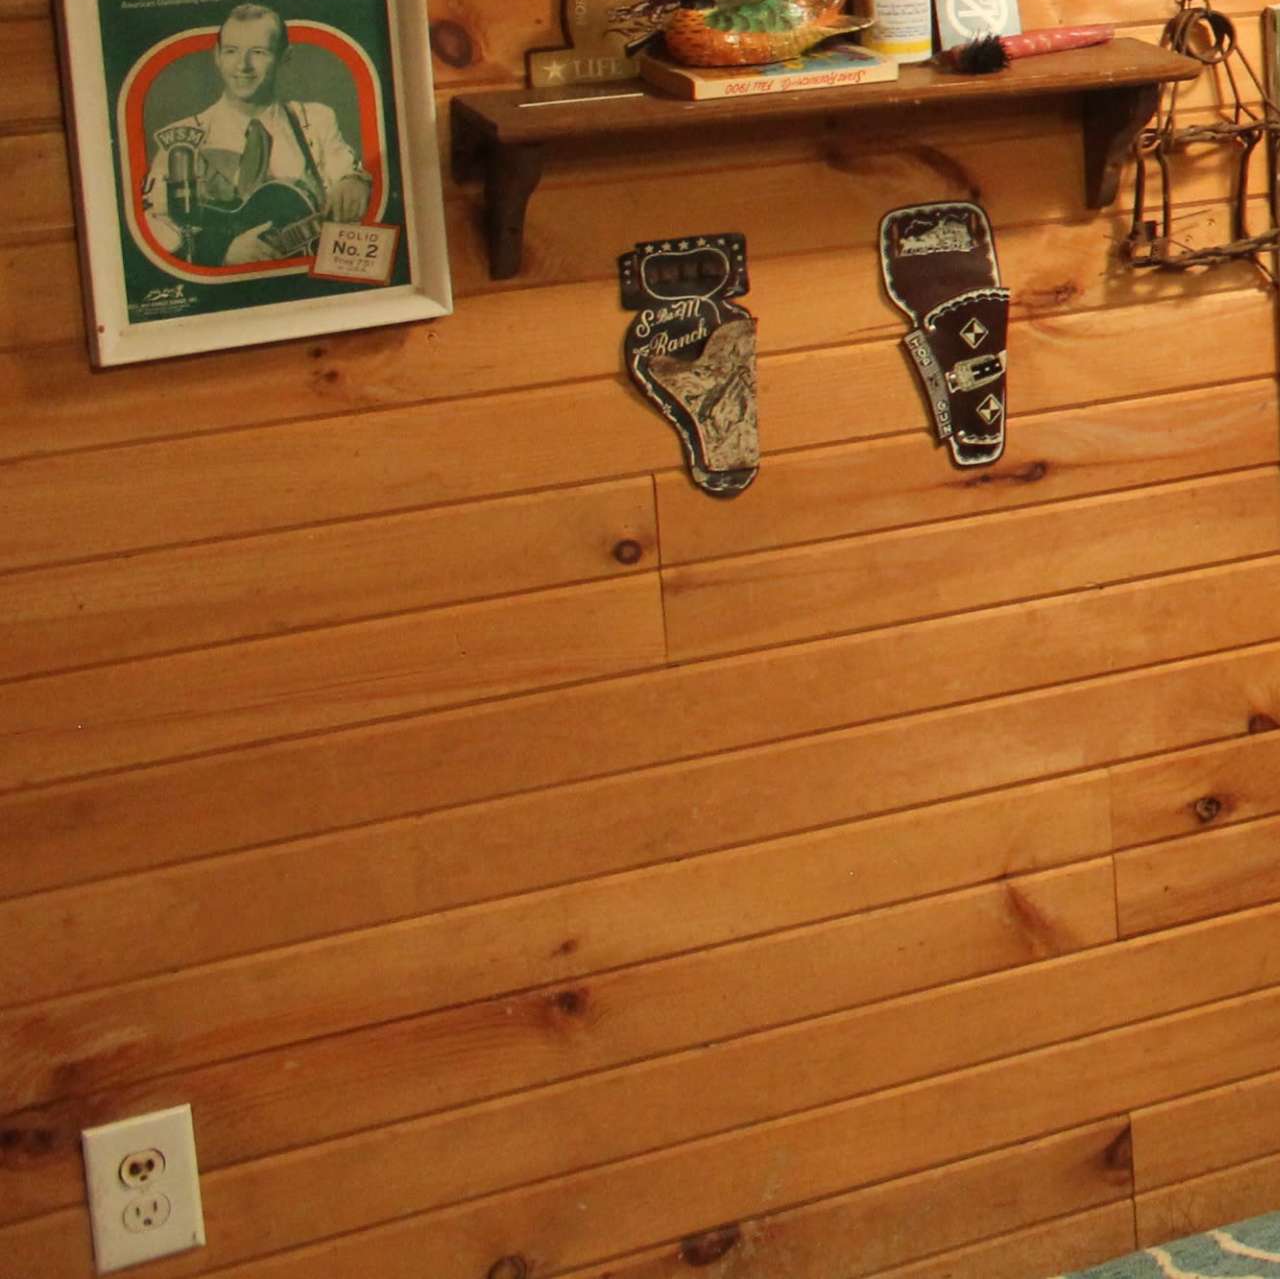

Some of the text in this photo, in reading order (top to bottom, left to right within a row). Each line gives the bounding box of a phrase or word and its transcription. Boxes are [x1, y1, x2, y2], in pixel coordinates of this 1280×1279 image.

[158, 128, 204, 146] WSM
[338, 230, 379, 243] FOLIO
[332, 240, 379, 259] No. 2
[649, 317, 708, 357] Ranch
